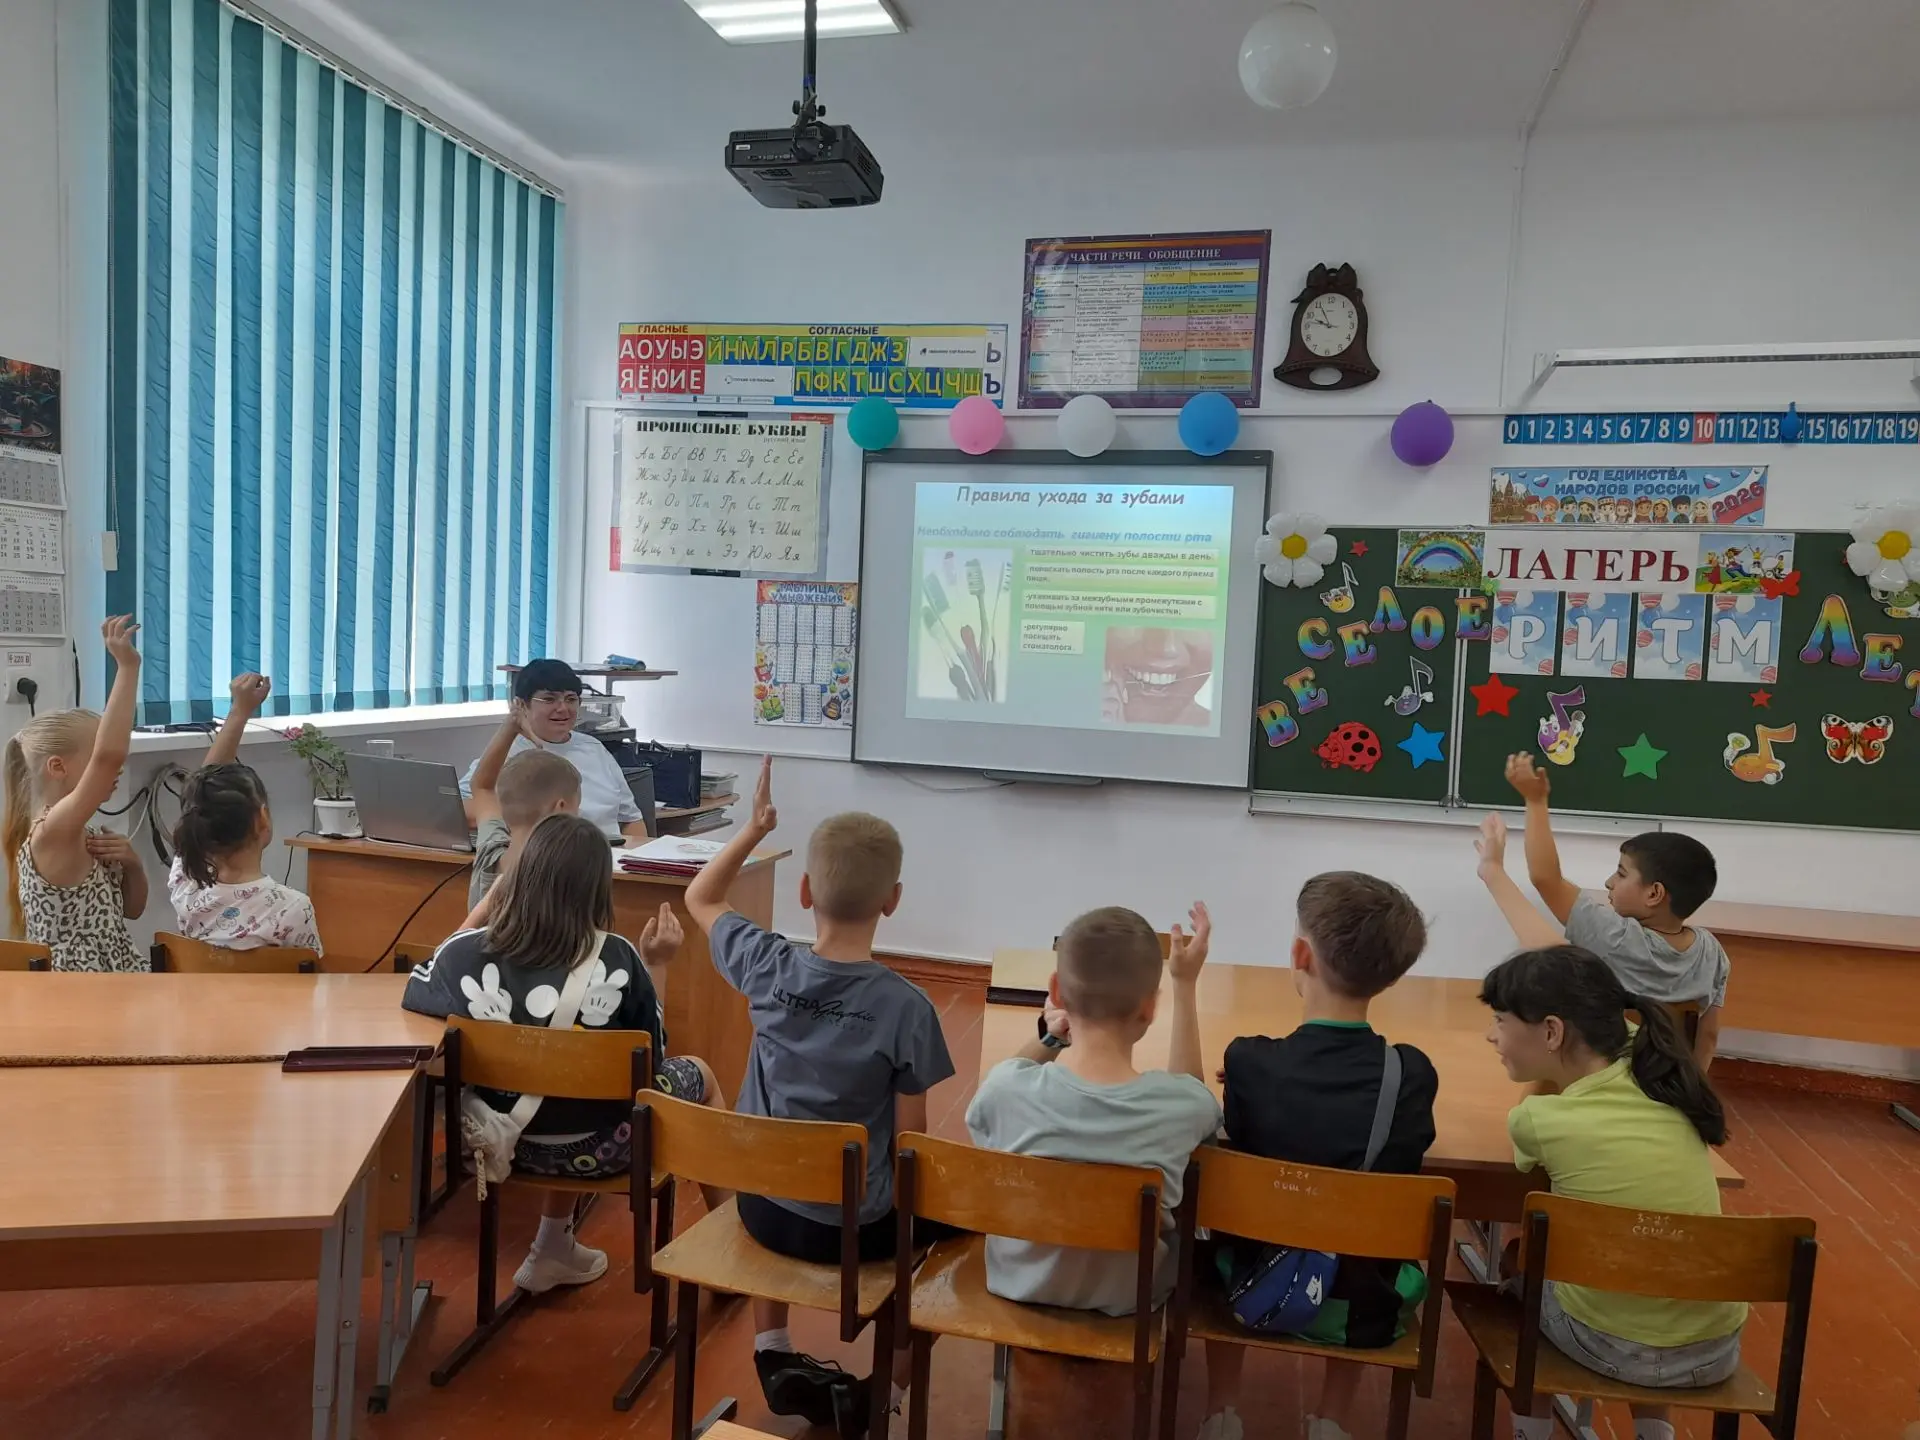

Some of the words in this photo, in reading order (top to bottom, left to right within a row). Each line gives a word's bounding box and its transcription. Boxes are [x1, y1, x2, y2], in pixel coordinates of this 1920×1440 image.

[1070, 251, 1107, 262] ЧАСТИ
[1112, 250, 1143, 261] РЕЧИ.
[1149, 248, 1221, 260] ОБОБЩЕНИЕ
[638, 325, 688, 334] ГЛАСНЫЕ
[808, 326, 879, 335] СОГЛАСНЫЕ
[637, 420, 741, 435] ПРОПИСНЫЕ
[748, 424, 807, 437] БУКВЫ
[1508, 420, 1519, 439] 0
[1528, 420, 1536, 439] 1
[1545, 419, 1556, 439] 2
[1563, 419, 1574, 439] 3
[1582, 419, 1594, 438] 4
[1601, 419, 1612, 439] 5
[1620, 419, 1632, 438] 6
[1640, 419, 1651, 438] 7
[1658, 418, 1670, 439] 8
[1678, 418, 1690, 439] 9
[1697, 419, 1713, 438] 10
[1717, 419, 1734, 438] 11
[1740, 419, 1758, 438] 12
[1763, 419, 1779, 438] 13
[1808, 419, 1826, 439] 15
[1830, 419, 1849, 439] 16
[1852, 419, 1872, 439] 17
[1876, 419, 1895, 439] 18
[1899, 418, 1919, 439] 19
[1569, 469, 1599, 482] ГОД
[1603, 468, 1687, 482] ЕДИНСТВА
[957, 486, 1030, 506] Правила
[1038, 491, 1087, 507] ухода
[1096, 491, 1113, 505] за
[1120, 489, 1184, 508] зубами
[1555, 484, 1628, 496] НАРОДОВ
[1633, 484, 1699, 496] РОССИИ
[1712, 481, 1765, 517] 2026
[917, 525, 990, 538] Необходимо
[993, 527, 1064, 540] соблюдать
[1071, 530, 1120, 544] гигиену
[1124, 531, 1181, 542] полости
[1185, 533, 1212, 544] рта
[1079, 550, 1114, 558] чистить
[1117, 549, 1139, 560] зубы
[1142, 551, 1178, 561] дважды
[1487, 547, 1690, 582] ЛАГЕРЬ
[1071, 567, 1104, 575] полость
[1106, 568, 1120, 576] рта
[1121, 568, 1146, 576] после
[1147, 569, 1181, 578] каждого
[1182, 570, 1214, 579] приема
[778, 583, 835, 593] ТАБЛИЦА
[771, 592, 843, 603] УМНОЖЕНИЯ
[1071, 594, 1080, 602] за
[1115, 605, 1131, 613] или
[1508, 615, 1772, 665] РИТМ
[186, 893, 214, 912] LOVE
